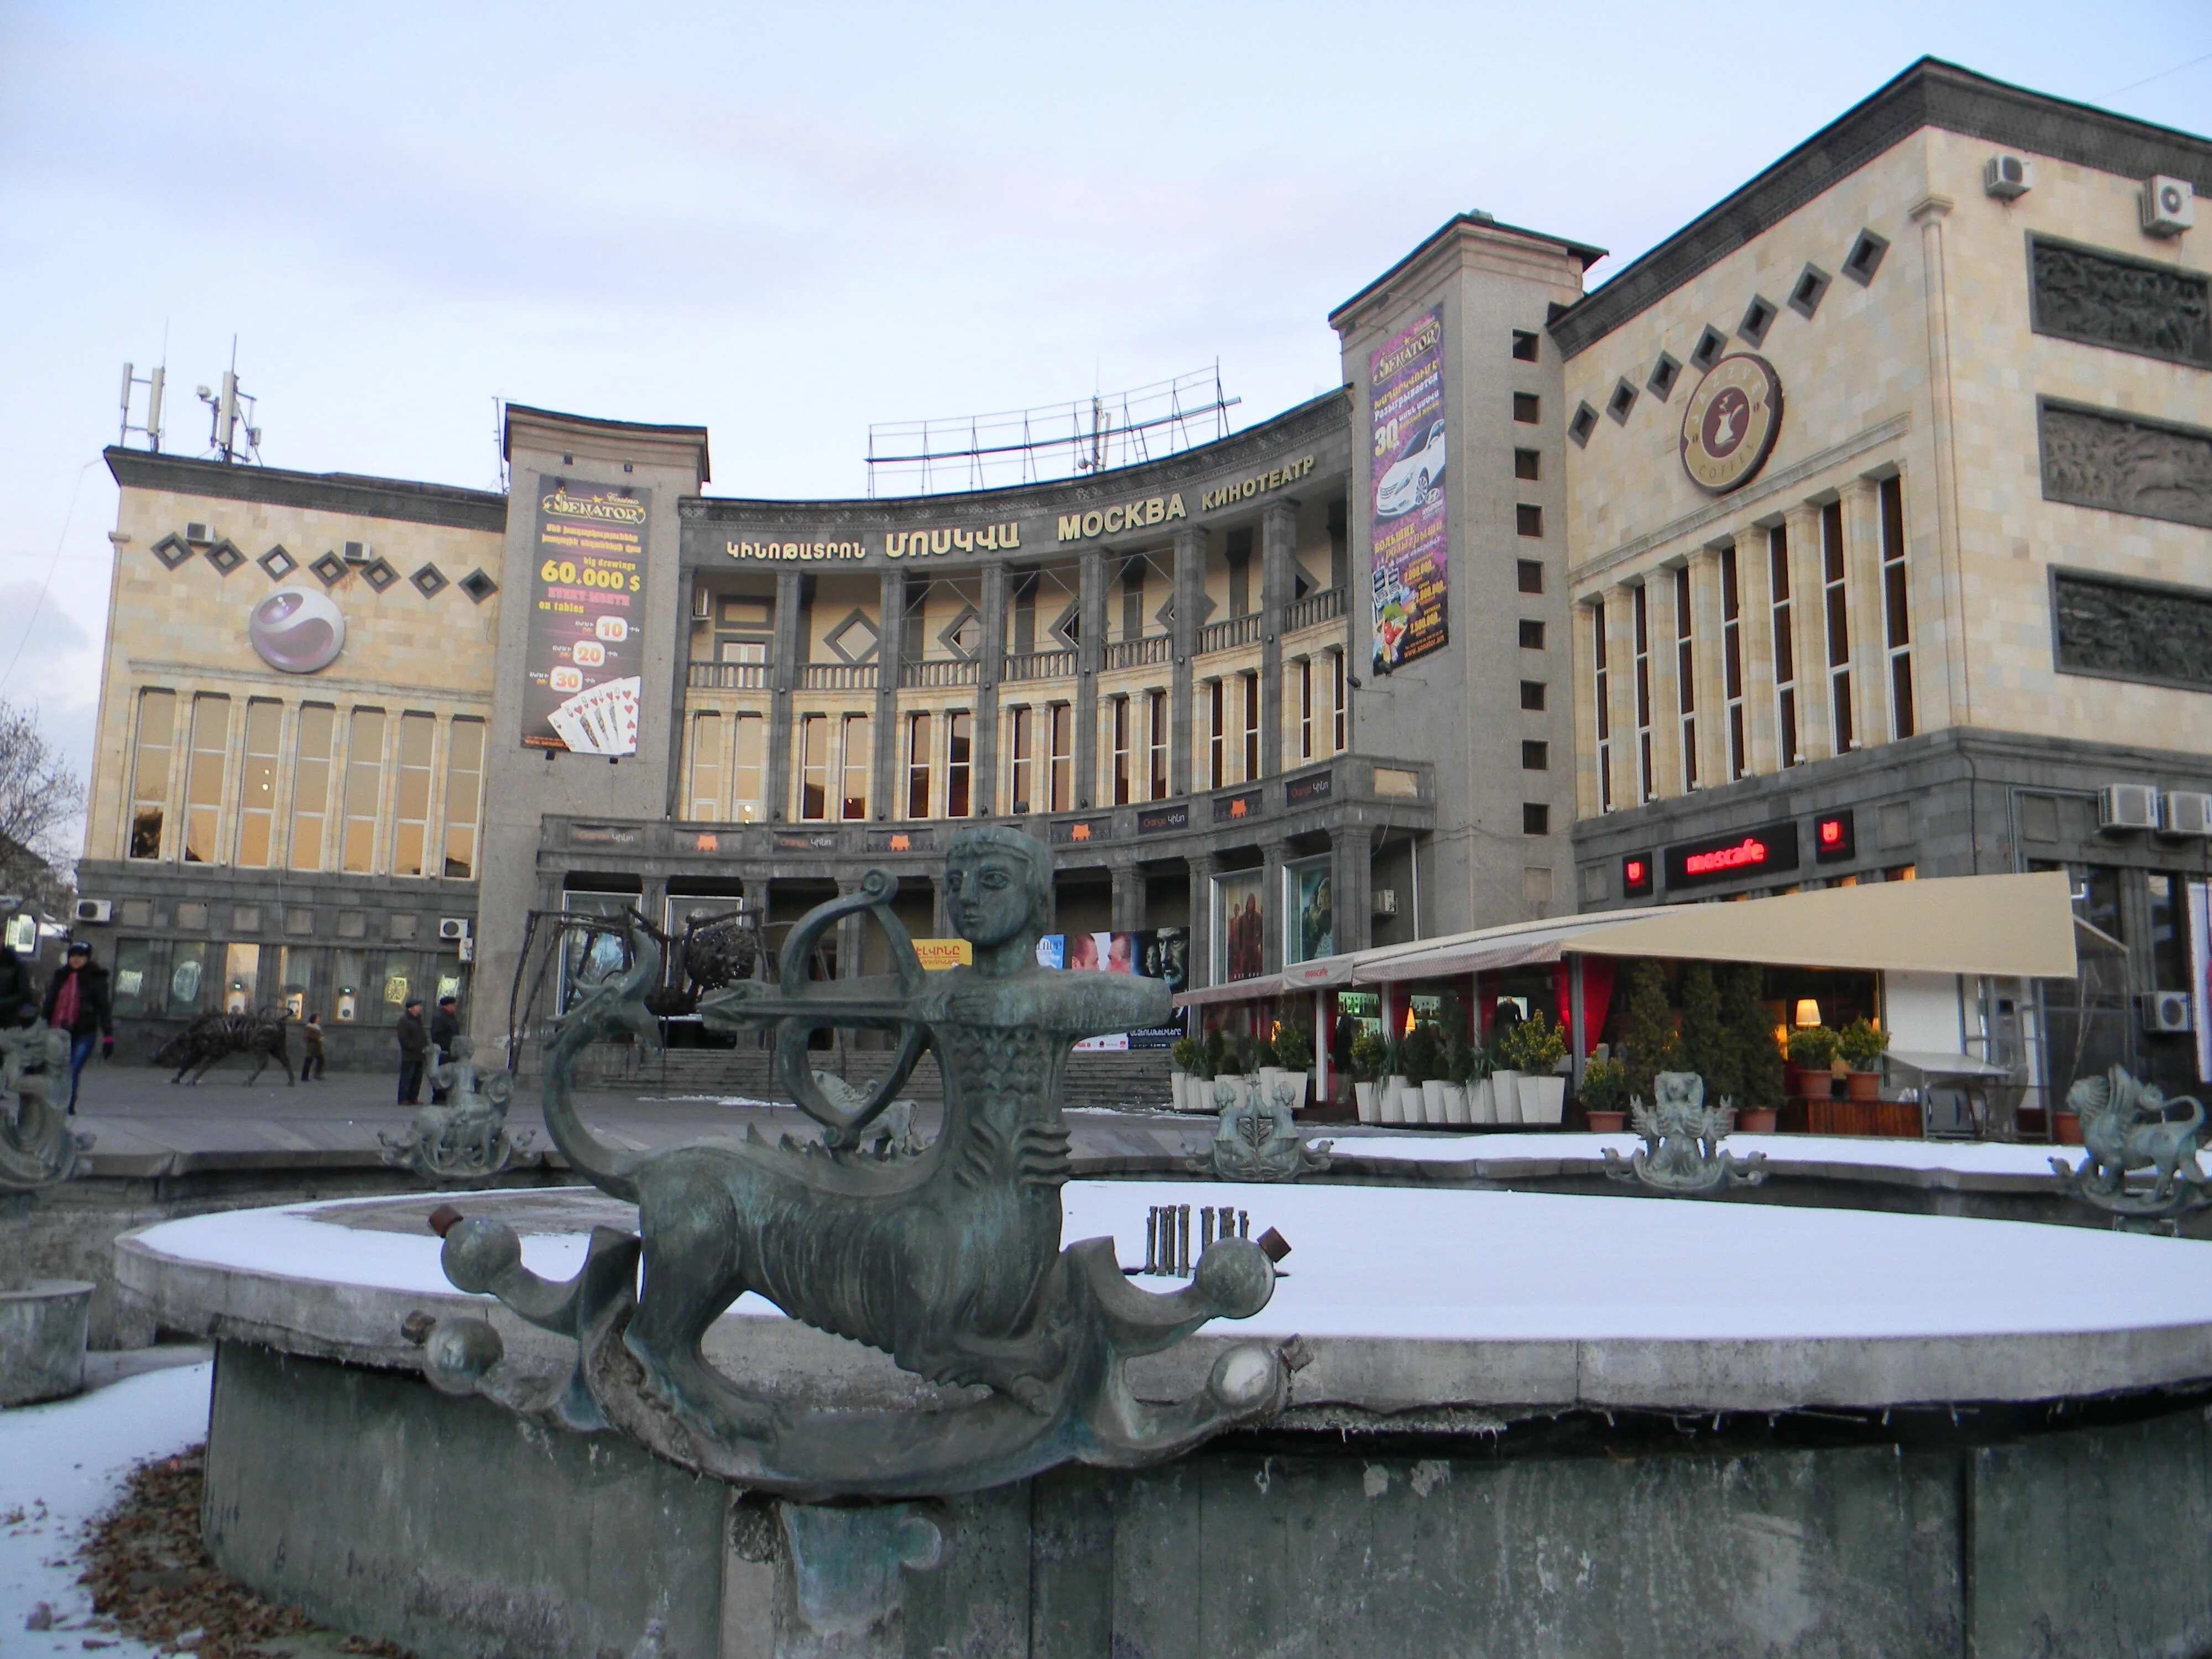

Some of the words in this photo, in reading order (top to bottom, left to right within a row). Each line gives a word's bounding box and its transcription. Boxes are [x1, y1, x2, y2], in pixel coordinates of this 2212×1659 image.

[1380, 329, 1437, 378] SENATOR
[554, 492, 640, 524] SENATOR
[1058, 493, 1187, 541] МОСКВА
[1202, 455, 1315, 512] КИНОТЕАТР
[726, 541, 866, 560] ԿԻՆՈԹԱՏՐՈՆ
[885, 522, 1020, 558] ՄՈՍԿՎԱ
[584, 556, 596, 567] big
[598, 559, 636, 571] drawings
[541, 559, 624, 590] 60.000
[629, 575, 640, 592] $
[548, 586, 587, 601] EVERY
[589, 591, 630, 606] MONTH
[539, 601, 551, 611] on
[555, 602, 585, 614] tables
[602, 622, 623, 638] 10
[578, 646, 601, 662] 20
[555, 672, 580, 688] 30
[1687, 838, 1766, 874] moscafe
[1305, 966, 1328, 979] moscafe
